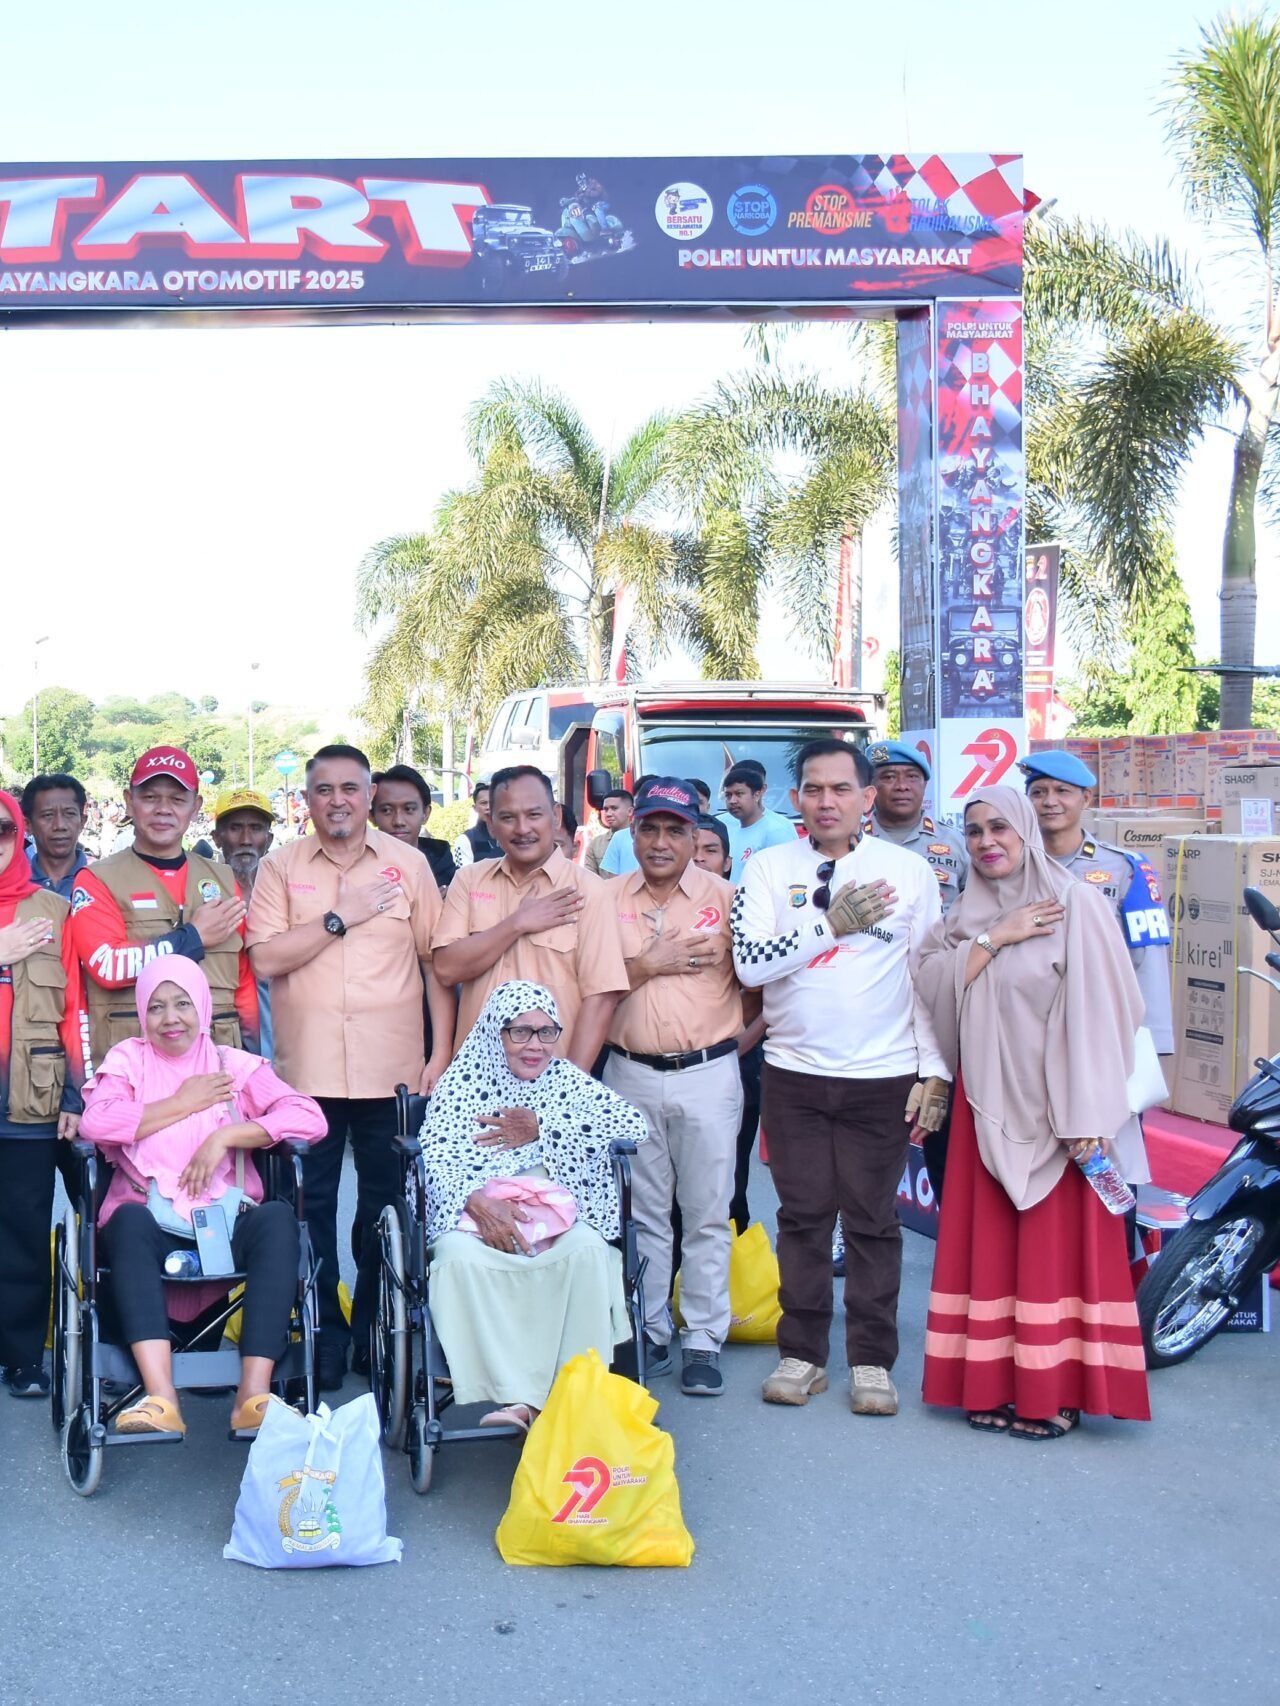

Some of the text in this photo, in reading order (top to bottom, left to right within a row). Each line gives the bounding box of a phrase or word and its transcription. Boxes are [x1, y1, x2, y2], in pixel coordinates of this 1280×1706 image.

[734, 201, 769, 212] STOP
[813, 195, 847, 211] STOP
[911, 198, 949, 214] TOLAK
[667, 216, 703, 224] BERSATU
[734, 212, 770, 220] NARKOBA
[787, 211, 873, 228] PREMANISME
[910, 215, 993, 231] RADIKALISME
[678, 248, 972, 267] POLRI UNTUK MASYARAKAT
[163, 272, 301, 292] OTOMOTIF
[305, 271, 365, 290] 2025
[946, 330, 1014, 339] MASYARAKAT
[1224, 775, 1255, 784] SHARP
[1124, 829, 1162, 842] Cosmos
[927, 856, 957, 868] OLRI
[1187, 941, 1221, 968] kirei
